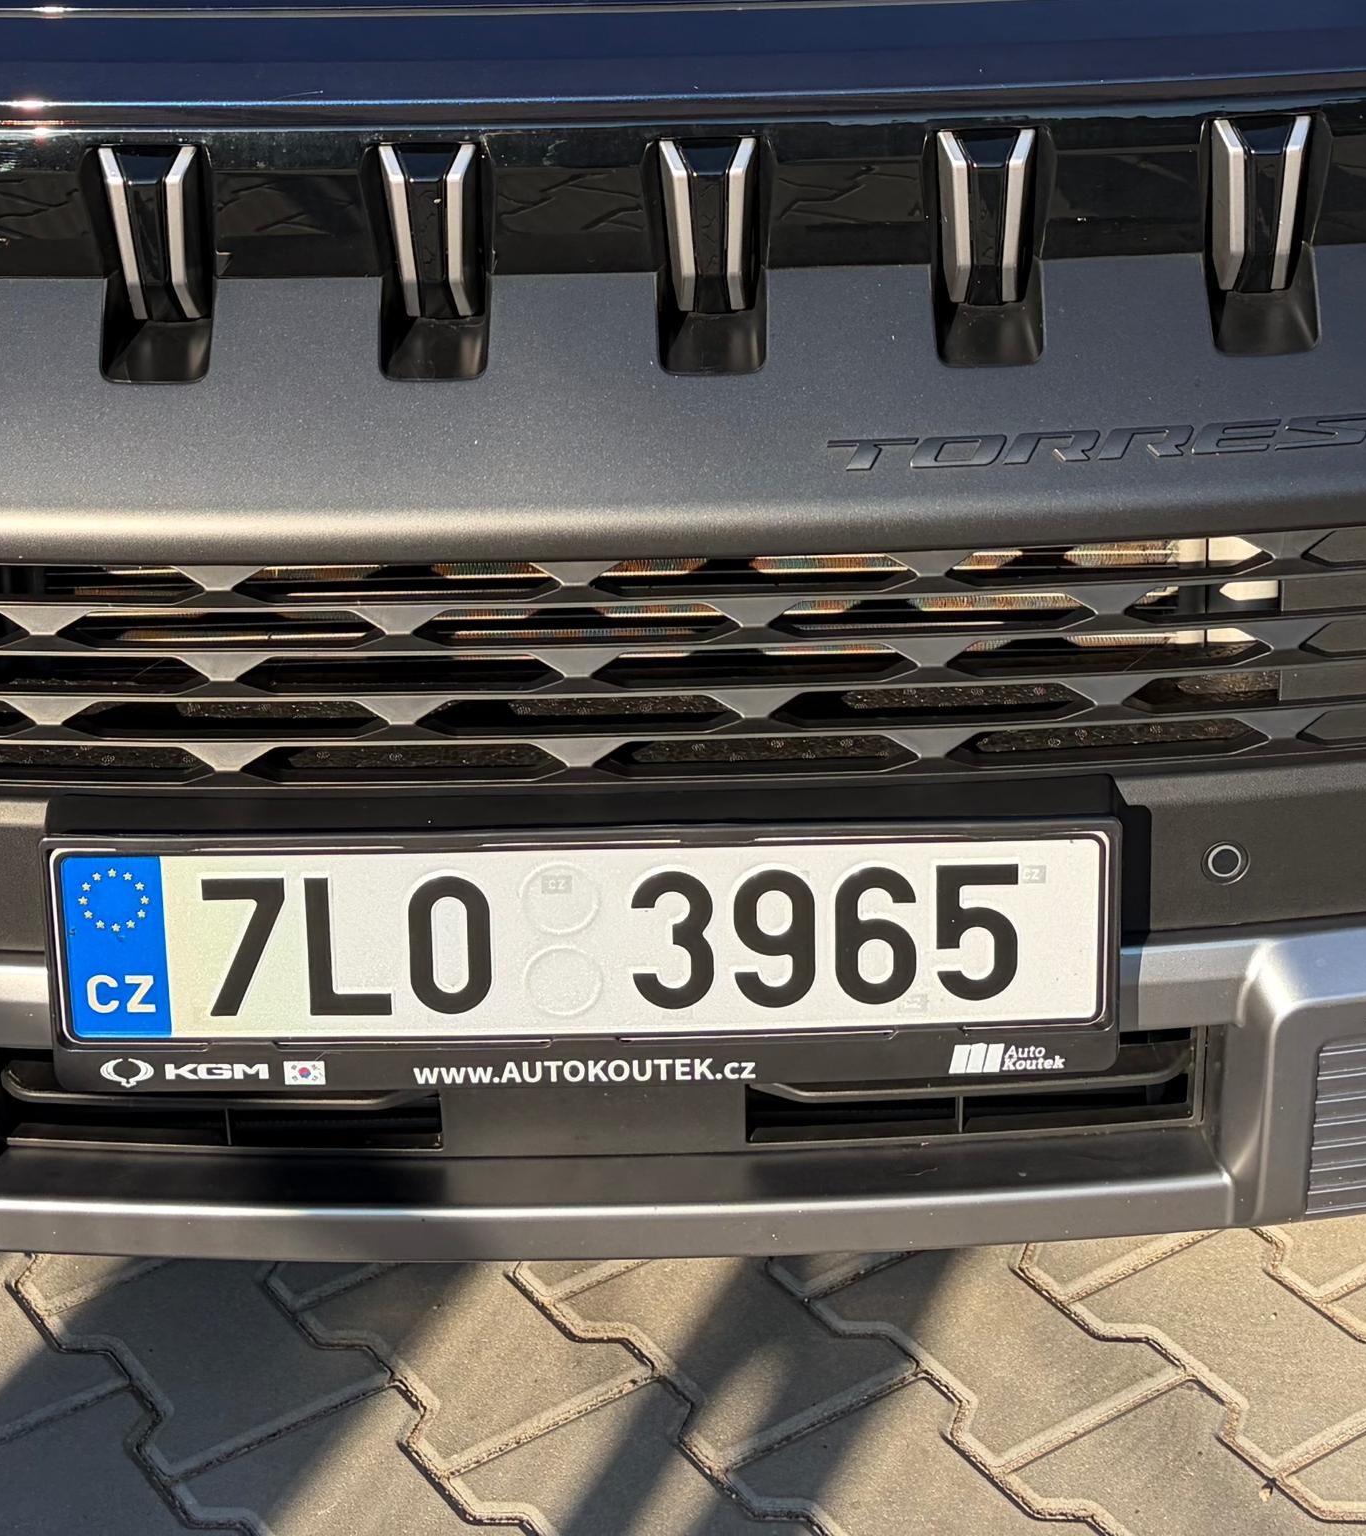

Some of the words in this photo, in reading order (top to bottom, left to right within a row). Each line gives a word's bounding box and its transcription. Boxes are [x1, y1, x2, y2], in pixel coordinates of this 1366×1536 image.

[200, 874, 493, 1017] 7L0
[630, 863, 1020, 1010] 3965
[86, 974, 157, 1014] CZ
[1002, 1055, 1066, 1071] Koutek
[1004, 1045, 1047, 1059] Auto
[164, 1063, 270, 1081] KGM
[412, 1058, 757, 1085] www.AUTOKOUTEK.cz
